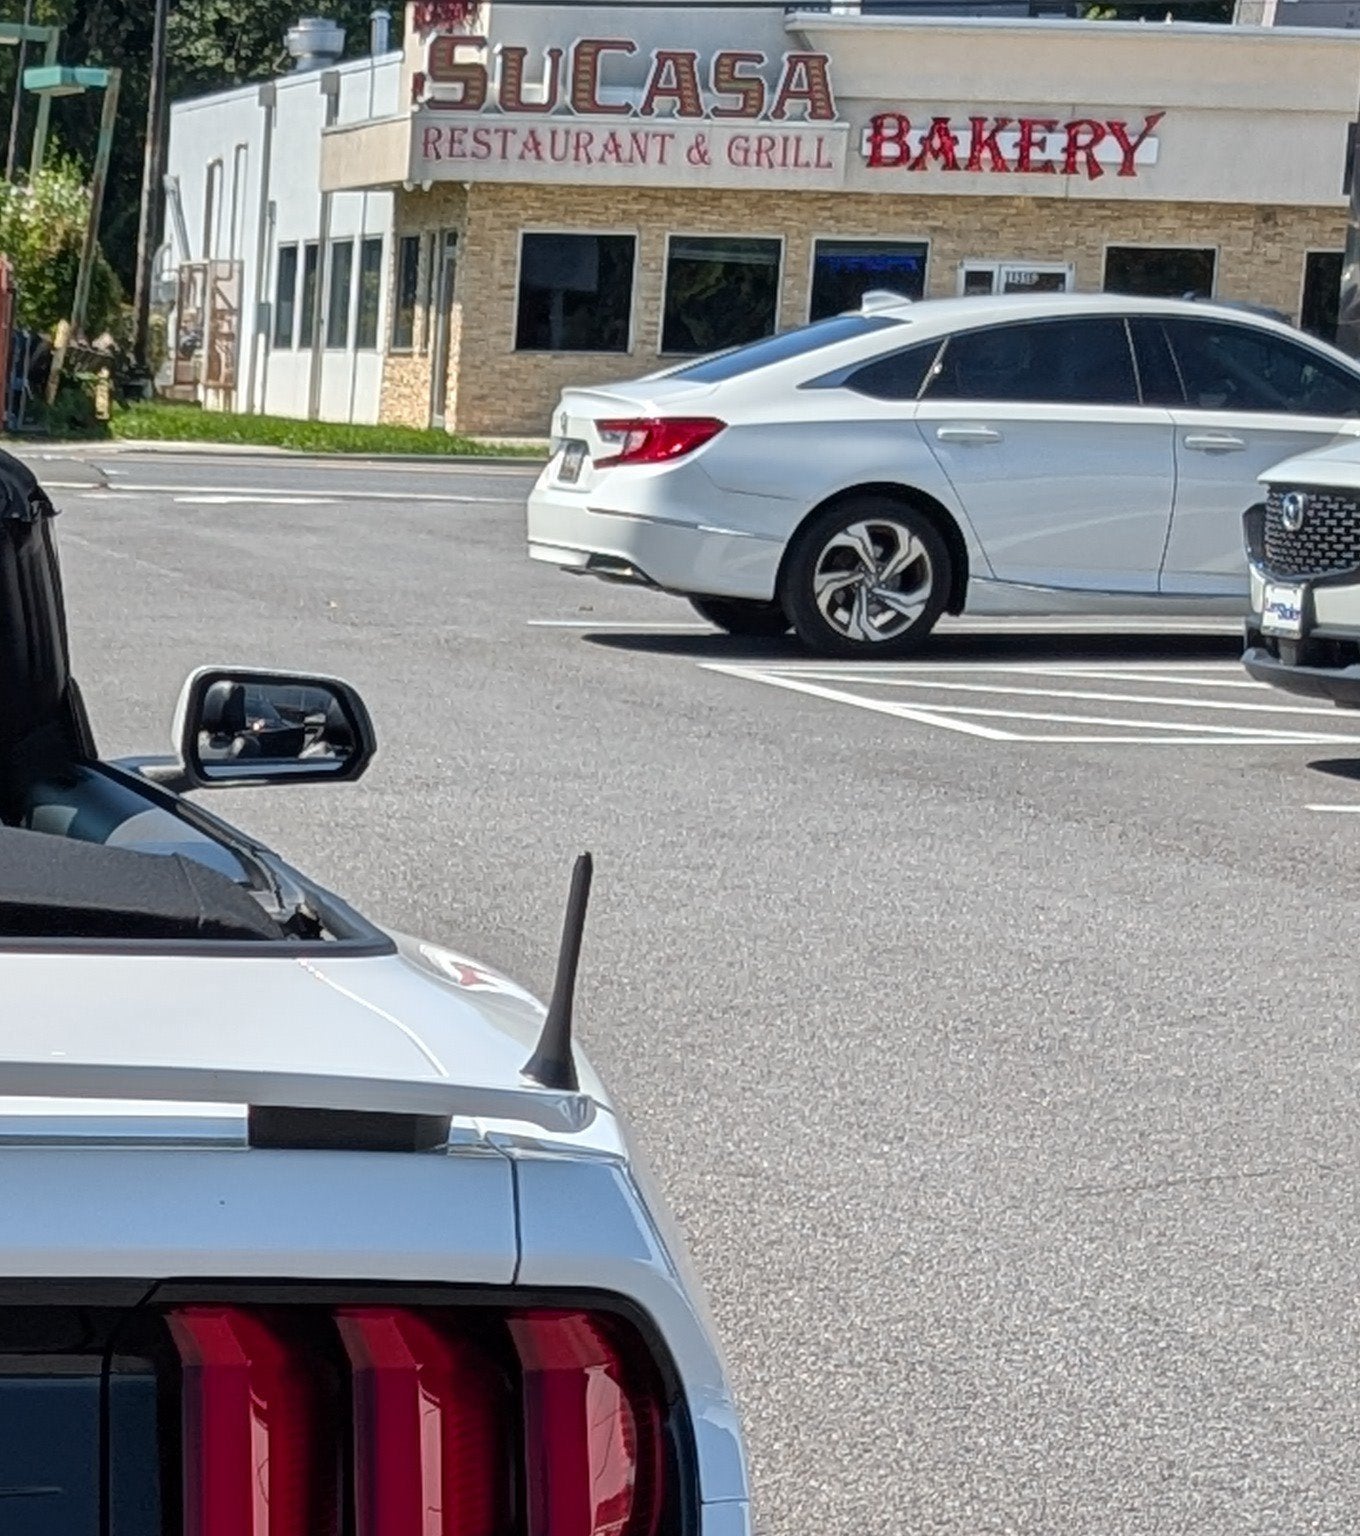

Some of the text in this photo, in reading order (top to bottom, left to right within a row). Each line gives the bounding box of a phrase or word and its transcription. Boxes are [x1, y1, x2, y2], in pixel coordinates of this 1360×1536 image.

[421, 126, 834, 170] RESTAURANT & GRILL
[866, 111, 1166, 181] BAKERY
